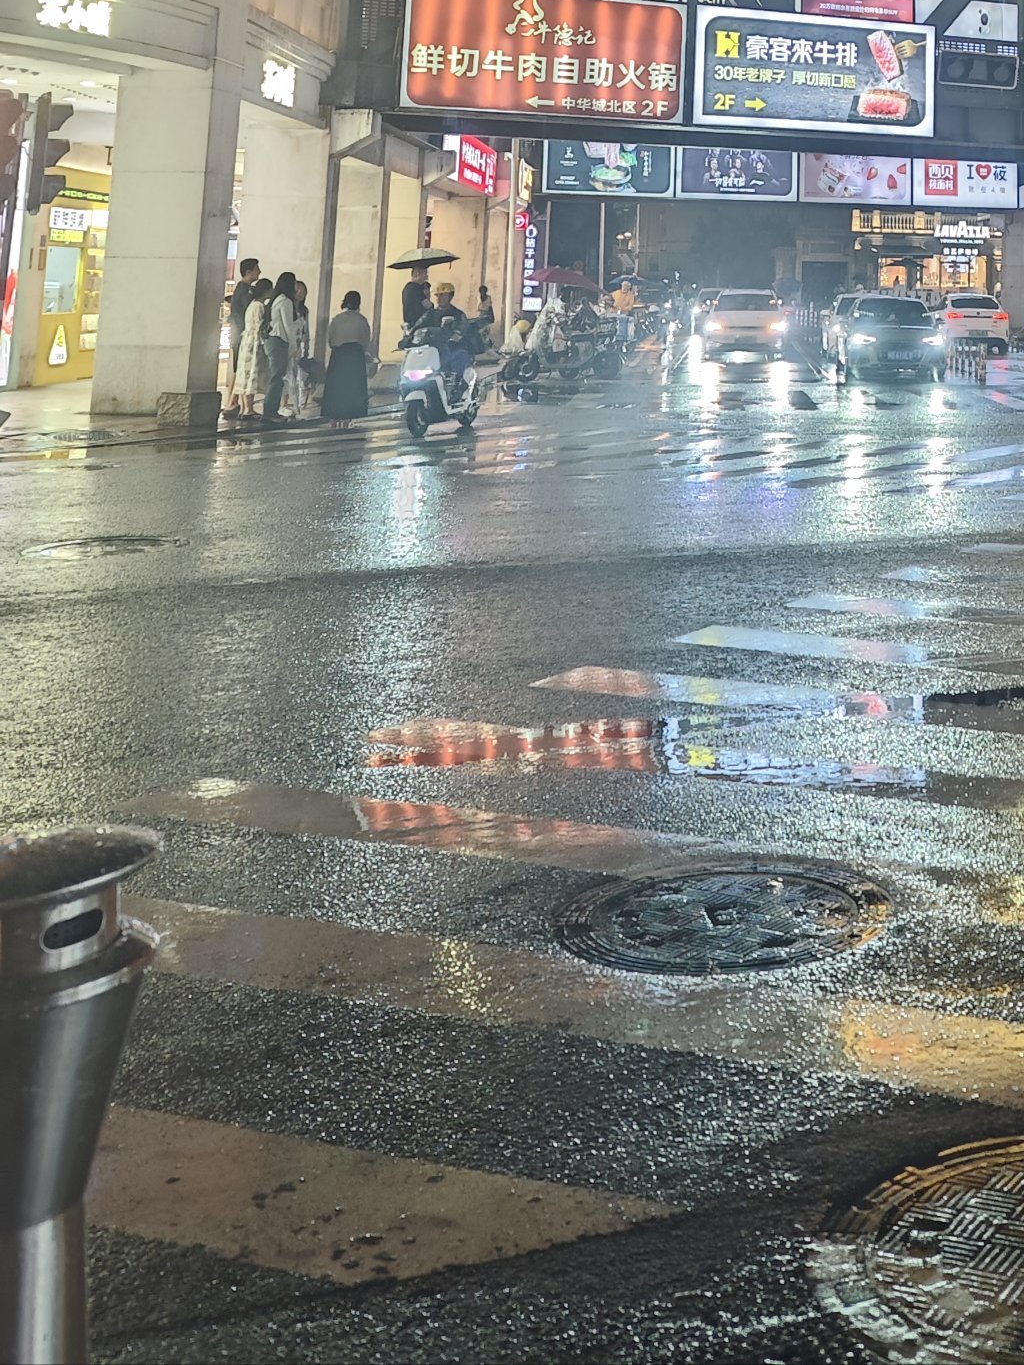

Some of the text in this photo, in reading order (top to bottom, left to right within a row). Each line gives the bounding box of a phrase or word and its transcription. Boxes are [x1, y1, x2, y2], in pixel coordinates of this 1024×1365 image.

[746, 34, 858, 67] 豪客來牛排
[410, 42, 679, 92] 鲜切牛肉自助火锅
[714, 65, 857, 90] 30年老牌子 厚切新口感
[561, 96, 669, 117] 中华城北区 2F
[713, 93, 736, 111] 2F
[928, 163, 954, 179] 西贝
[928, 179, 954, 191] 莜面村
[934, 221, 991, 239] LAVAZZA
